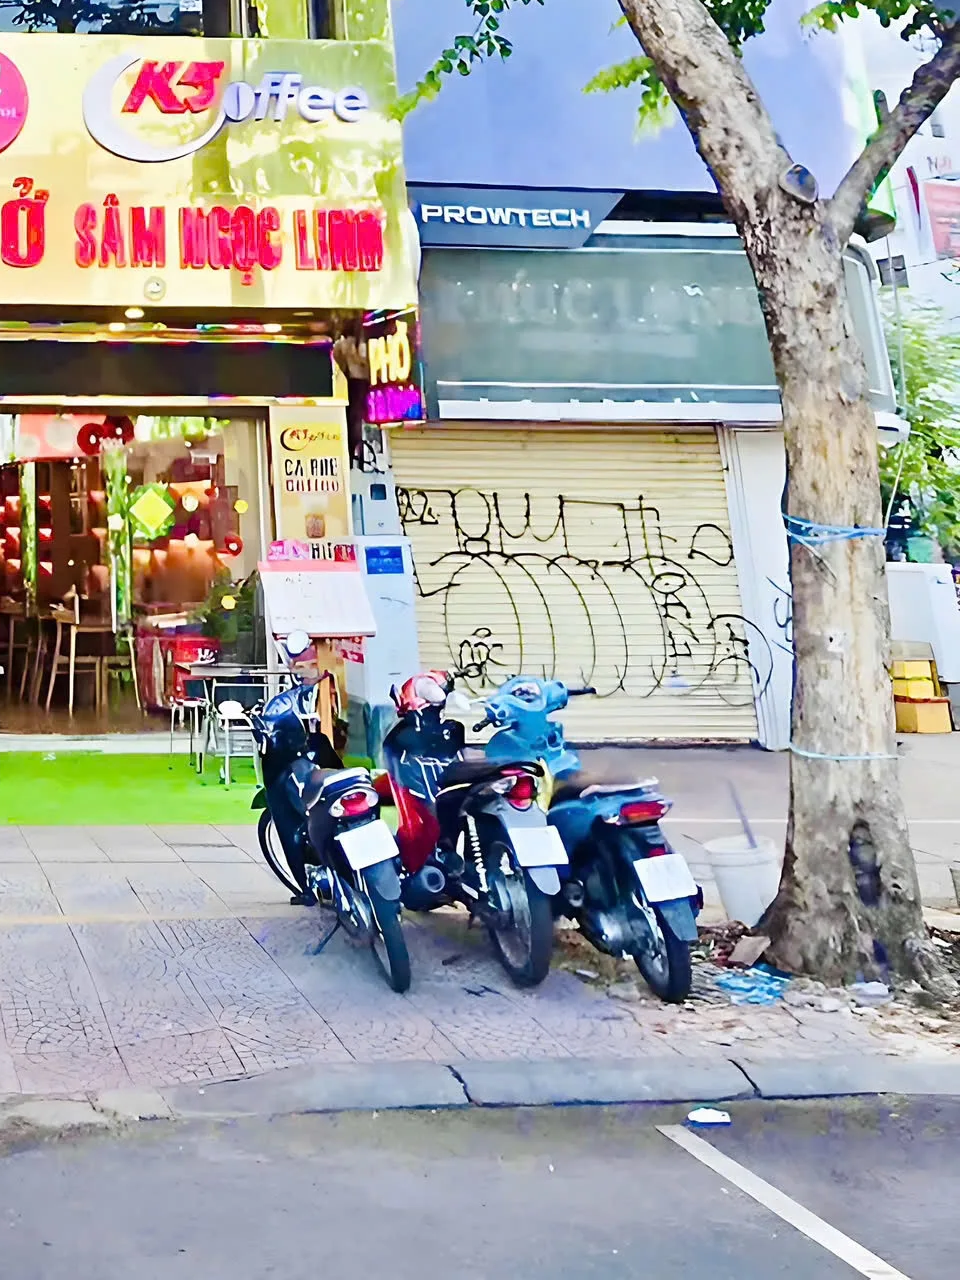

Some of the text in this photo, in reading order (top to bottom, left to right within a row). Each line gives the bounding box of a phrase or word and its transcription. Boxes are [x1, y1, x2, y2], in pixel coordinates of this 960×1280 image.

[74, 193, 166, 269] SÂM
[179, 206, 283, 286] NGỌC
[420, 204, 591, 228] PROWTECH
